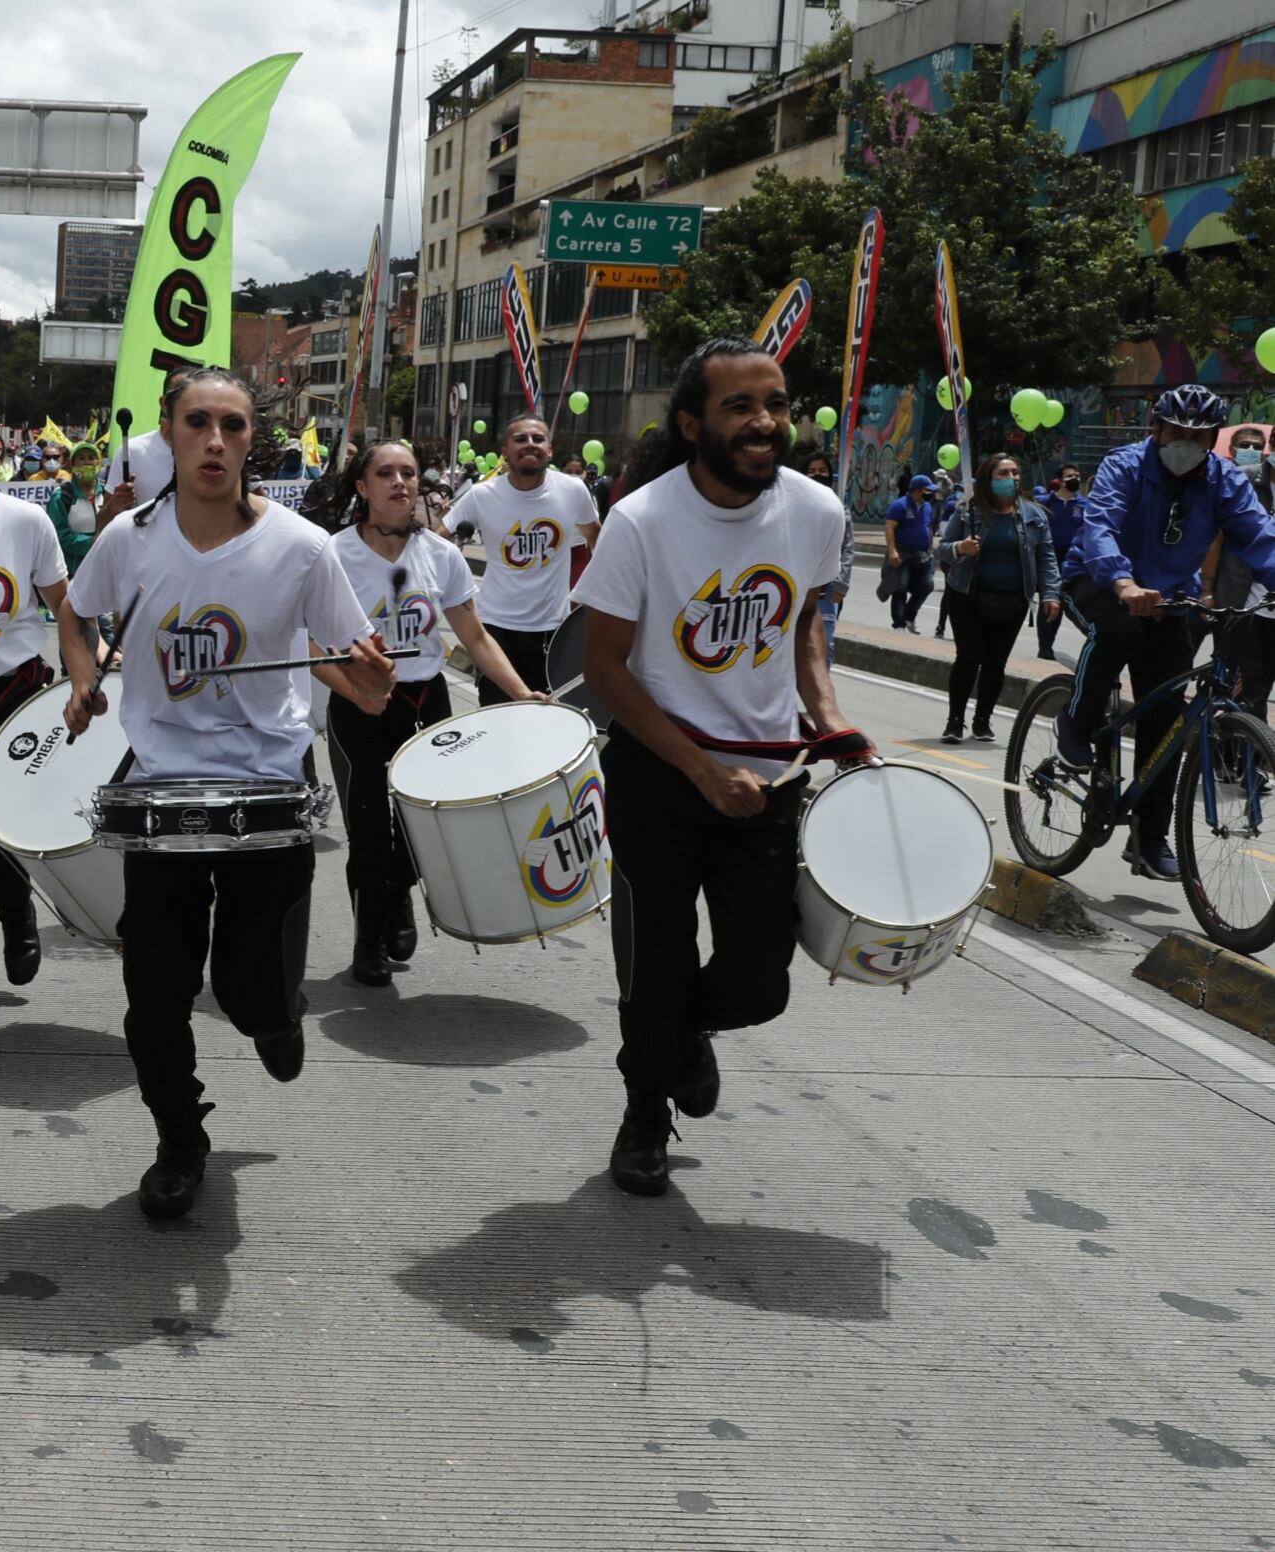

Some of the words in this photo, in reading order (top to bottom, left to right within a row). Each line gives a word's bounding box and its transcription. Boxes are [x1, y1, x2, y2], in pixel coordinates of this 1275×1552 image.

[188, 139, 229, 166] COLOMBIA
[581, 212, 606, 228] Av
[614, 214, 658, 230] Calle
[666, 216, 692, 232] 72
[556, 236, 622, 252] Carrera
[630, 239, 642, 253] 5
[612, 271, 622, 282] U
[849, 222, 875, 402] CUT
[507, 270, 540, 402] CUT
[516, 531, 547, 557] CUT
[707, 593, 769, 647] CUT
[172, 627, 218, 677] CUT
[25, 726, 64, 775] TIMBRA
[438, 731, 487, 756] TIMBRA
[551, 802, 602, 875] CUT
